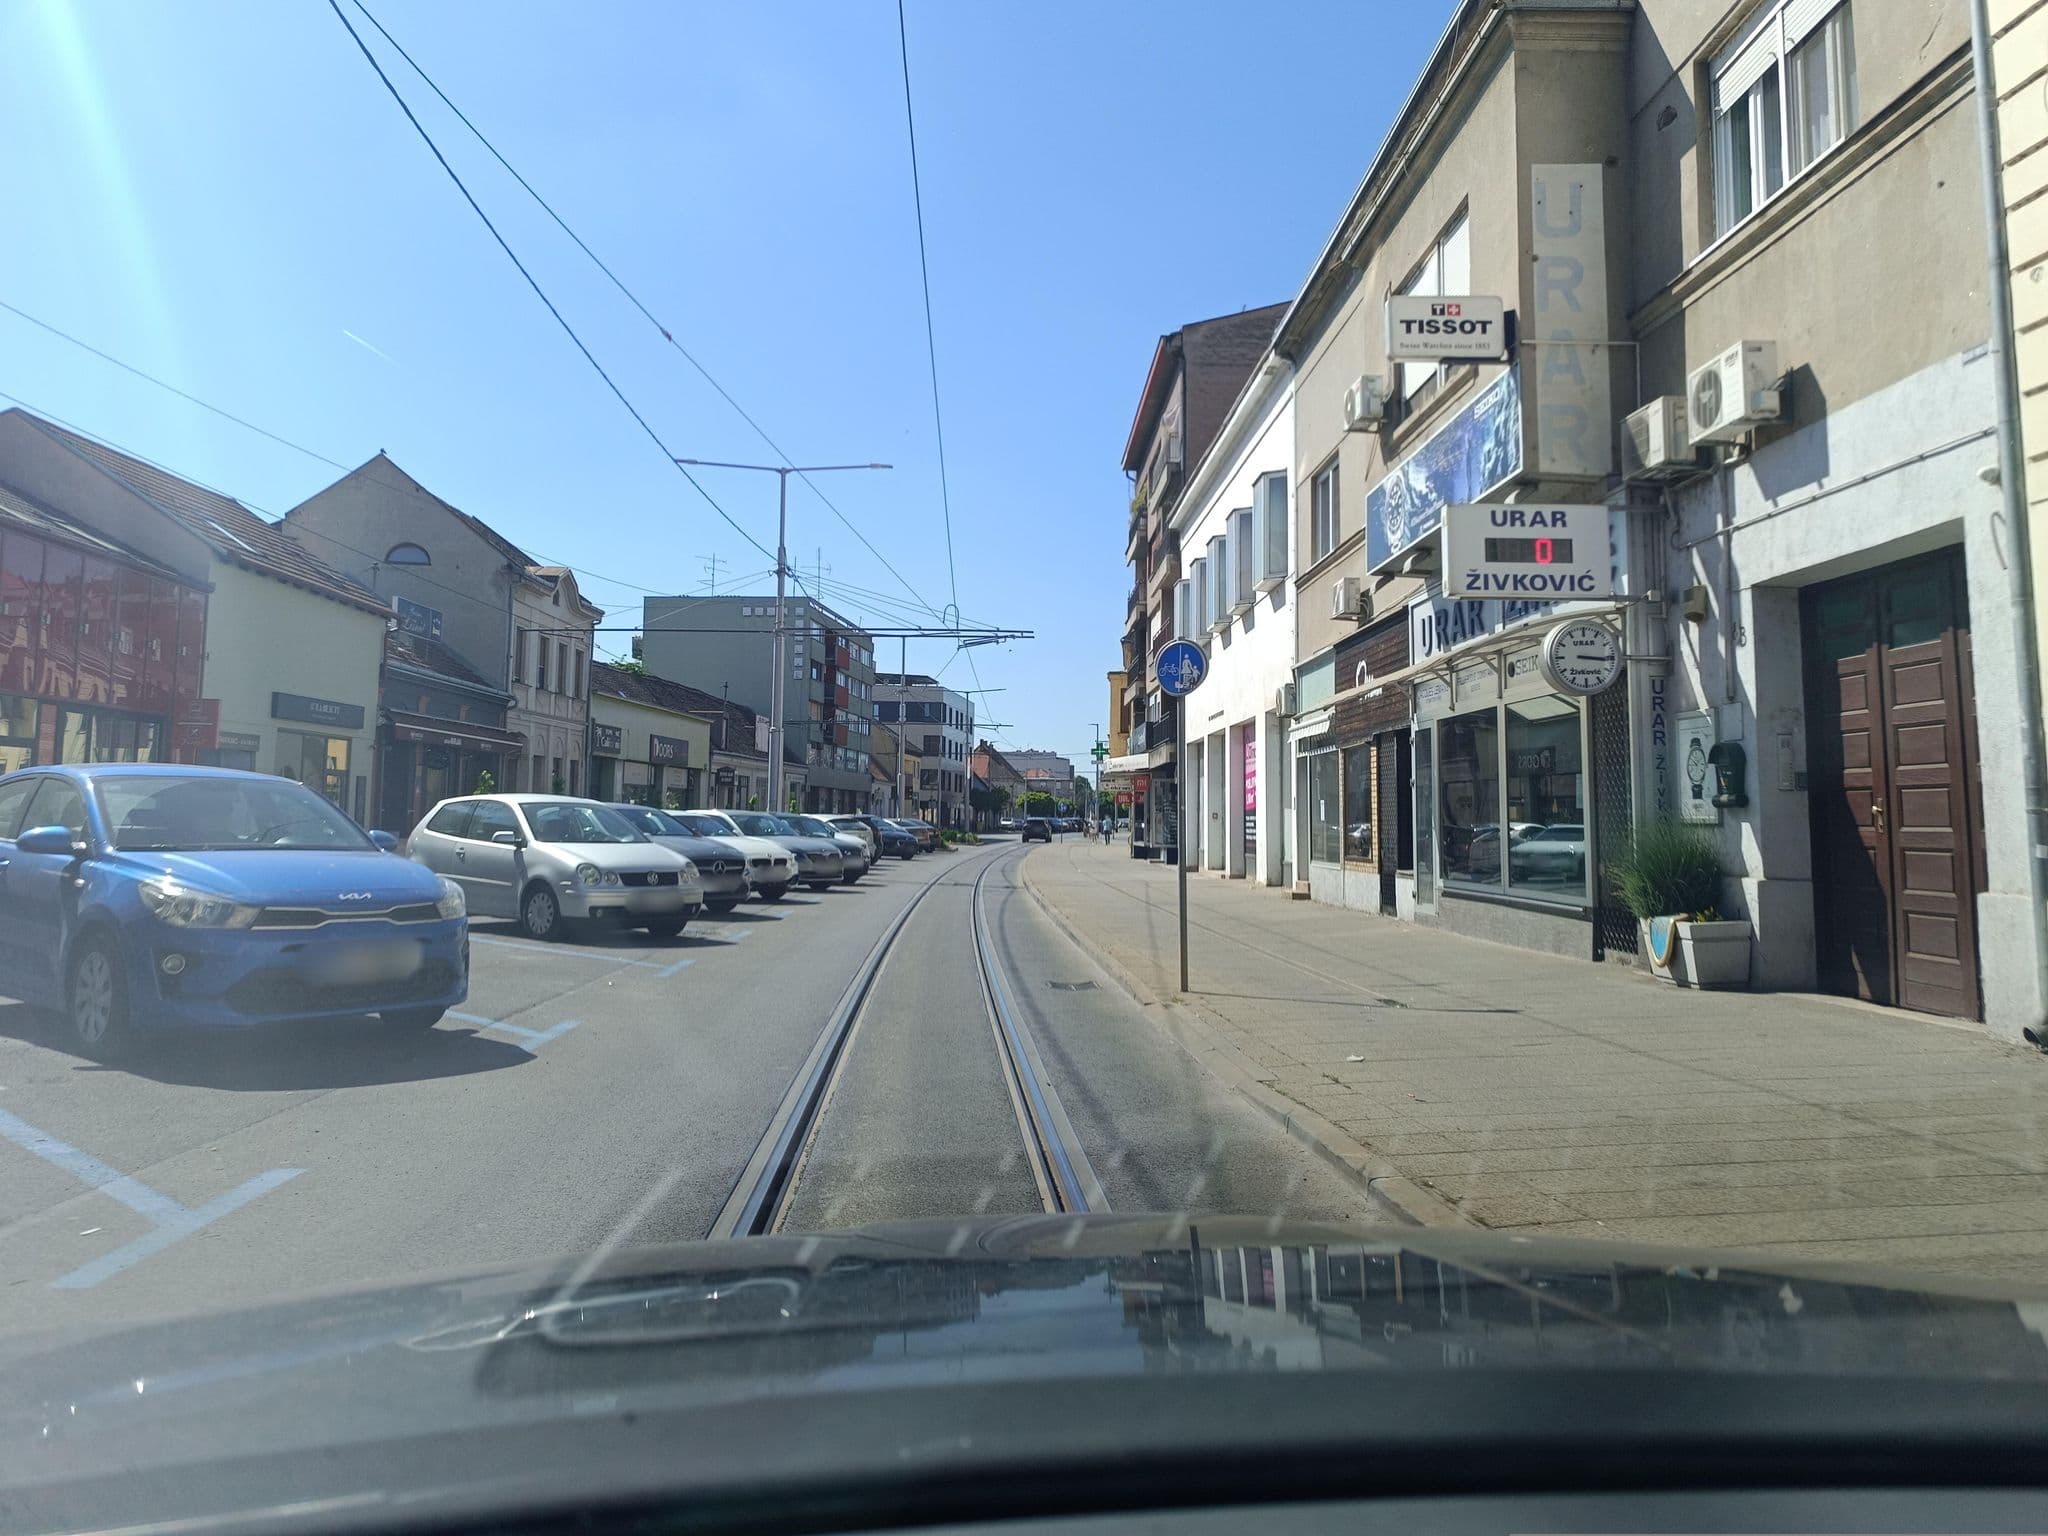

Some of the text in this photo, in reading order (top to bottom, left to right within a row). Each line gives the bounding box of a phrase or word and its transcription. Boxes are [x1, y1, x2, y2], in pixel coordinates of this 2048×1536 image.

[1399, 319, 1493, 335] TISSOT
[1534, 182, 1589, 465] URAR
[1490, 510, 1567, 527] URAR
[1535, 538, 1552, 563] 0
[1465, 569, 1596, 592] ŽIVKOVIĆ
[1515, 655, 1539, 676] SEIK
[1651, 679, 1666, 746] URAR
